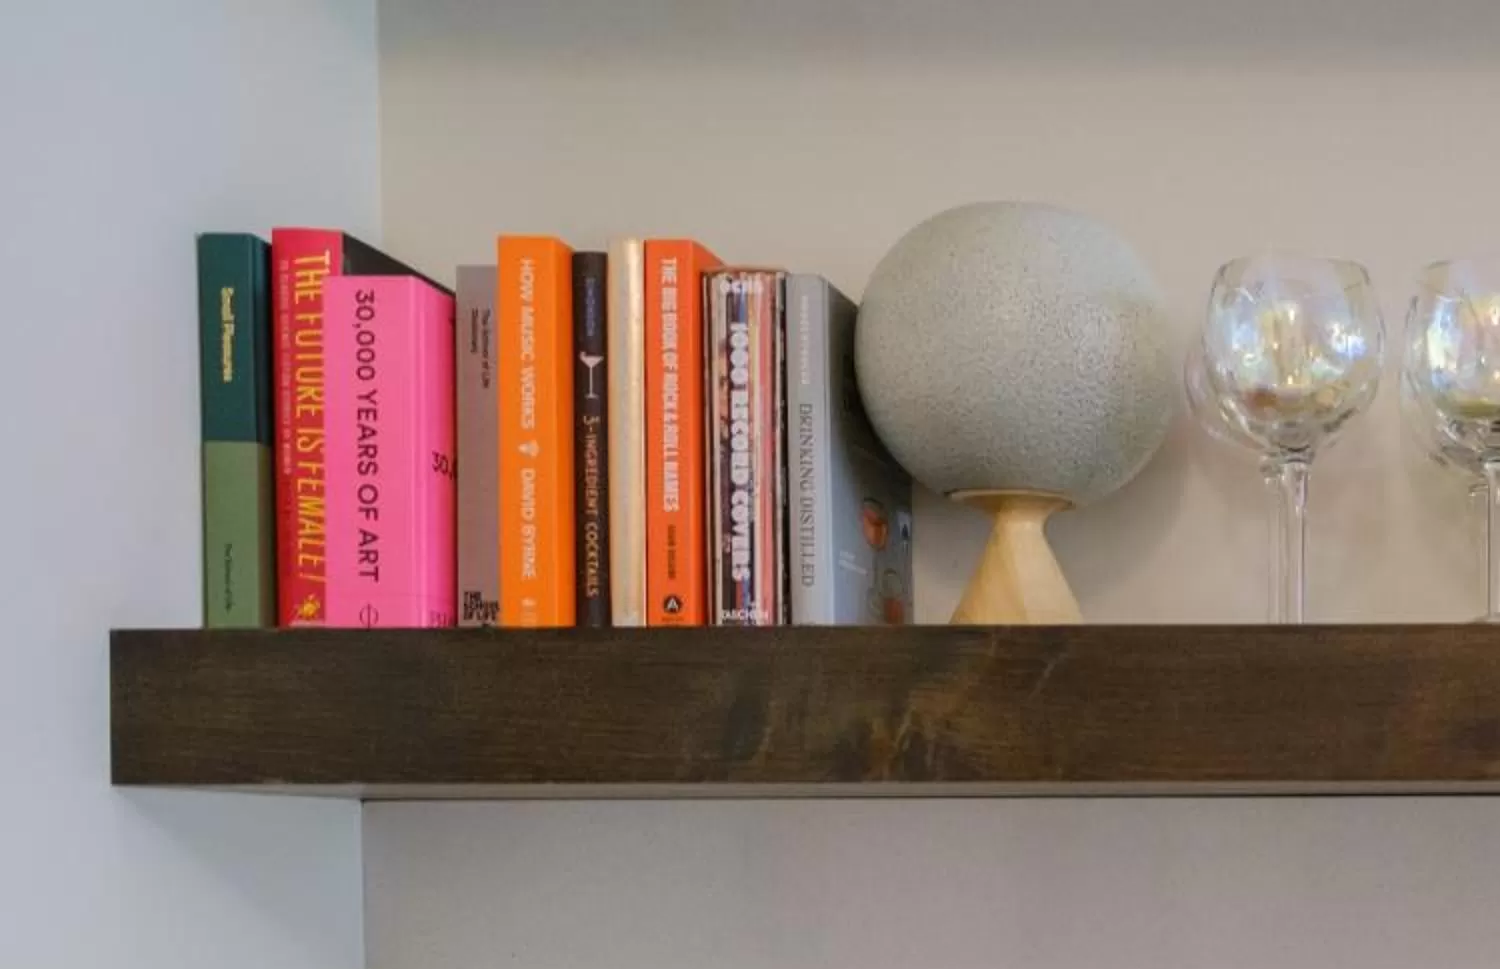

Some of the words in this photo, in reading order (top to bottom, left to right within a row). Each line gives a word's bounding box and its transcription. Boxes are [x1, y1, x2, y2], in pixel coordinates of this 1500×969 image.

[294, 250, 331, 304] THE
[520, 258, 536, 303] HOW
[660, 257, 678, 284] THE
[355, 289, 376, 381] 30,000
[520, 306, 536, 361] MUSIC
[661, 313, 678, 350] BOOK
[730, 322, 749, 385] 1000
[295, 313, 323, 417] FUTURE
[662, 352, 678, 370] OF
[520, 366, 536, 430] WORKS
[662, 372, 679, 409] ROCK
[296, 428, 324, 452] IS
[357, 389, 379, 476] YEARS
[663, 422, 679, 458] ROLL
[730, 389, 750, 485] RECORD
[799, 403, 814, 493] DRINKING
[357, 484, 379, 522] OF
[520, 468, 536, 521] DAVID
[663, 461, 680, 512] NAMES
[358, 528, 379, 582] ART
[521, 524, 537, 579] BYRNE
[585, 522, 600, 597] COCKTAILS
[731, 489, 750, 582] COVERS
[800, 497, 815, 587] DISTILLED
